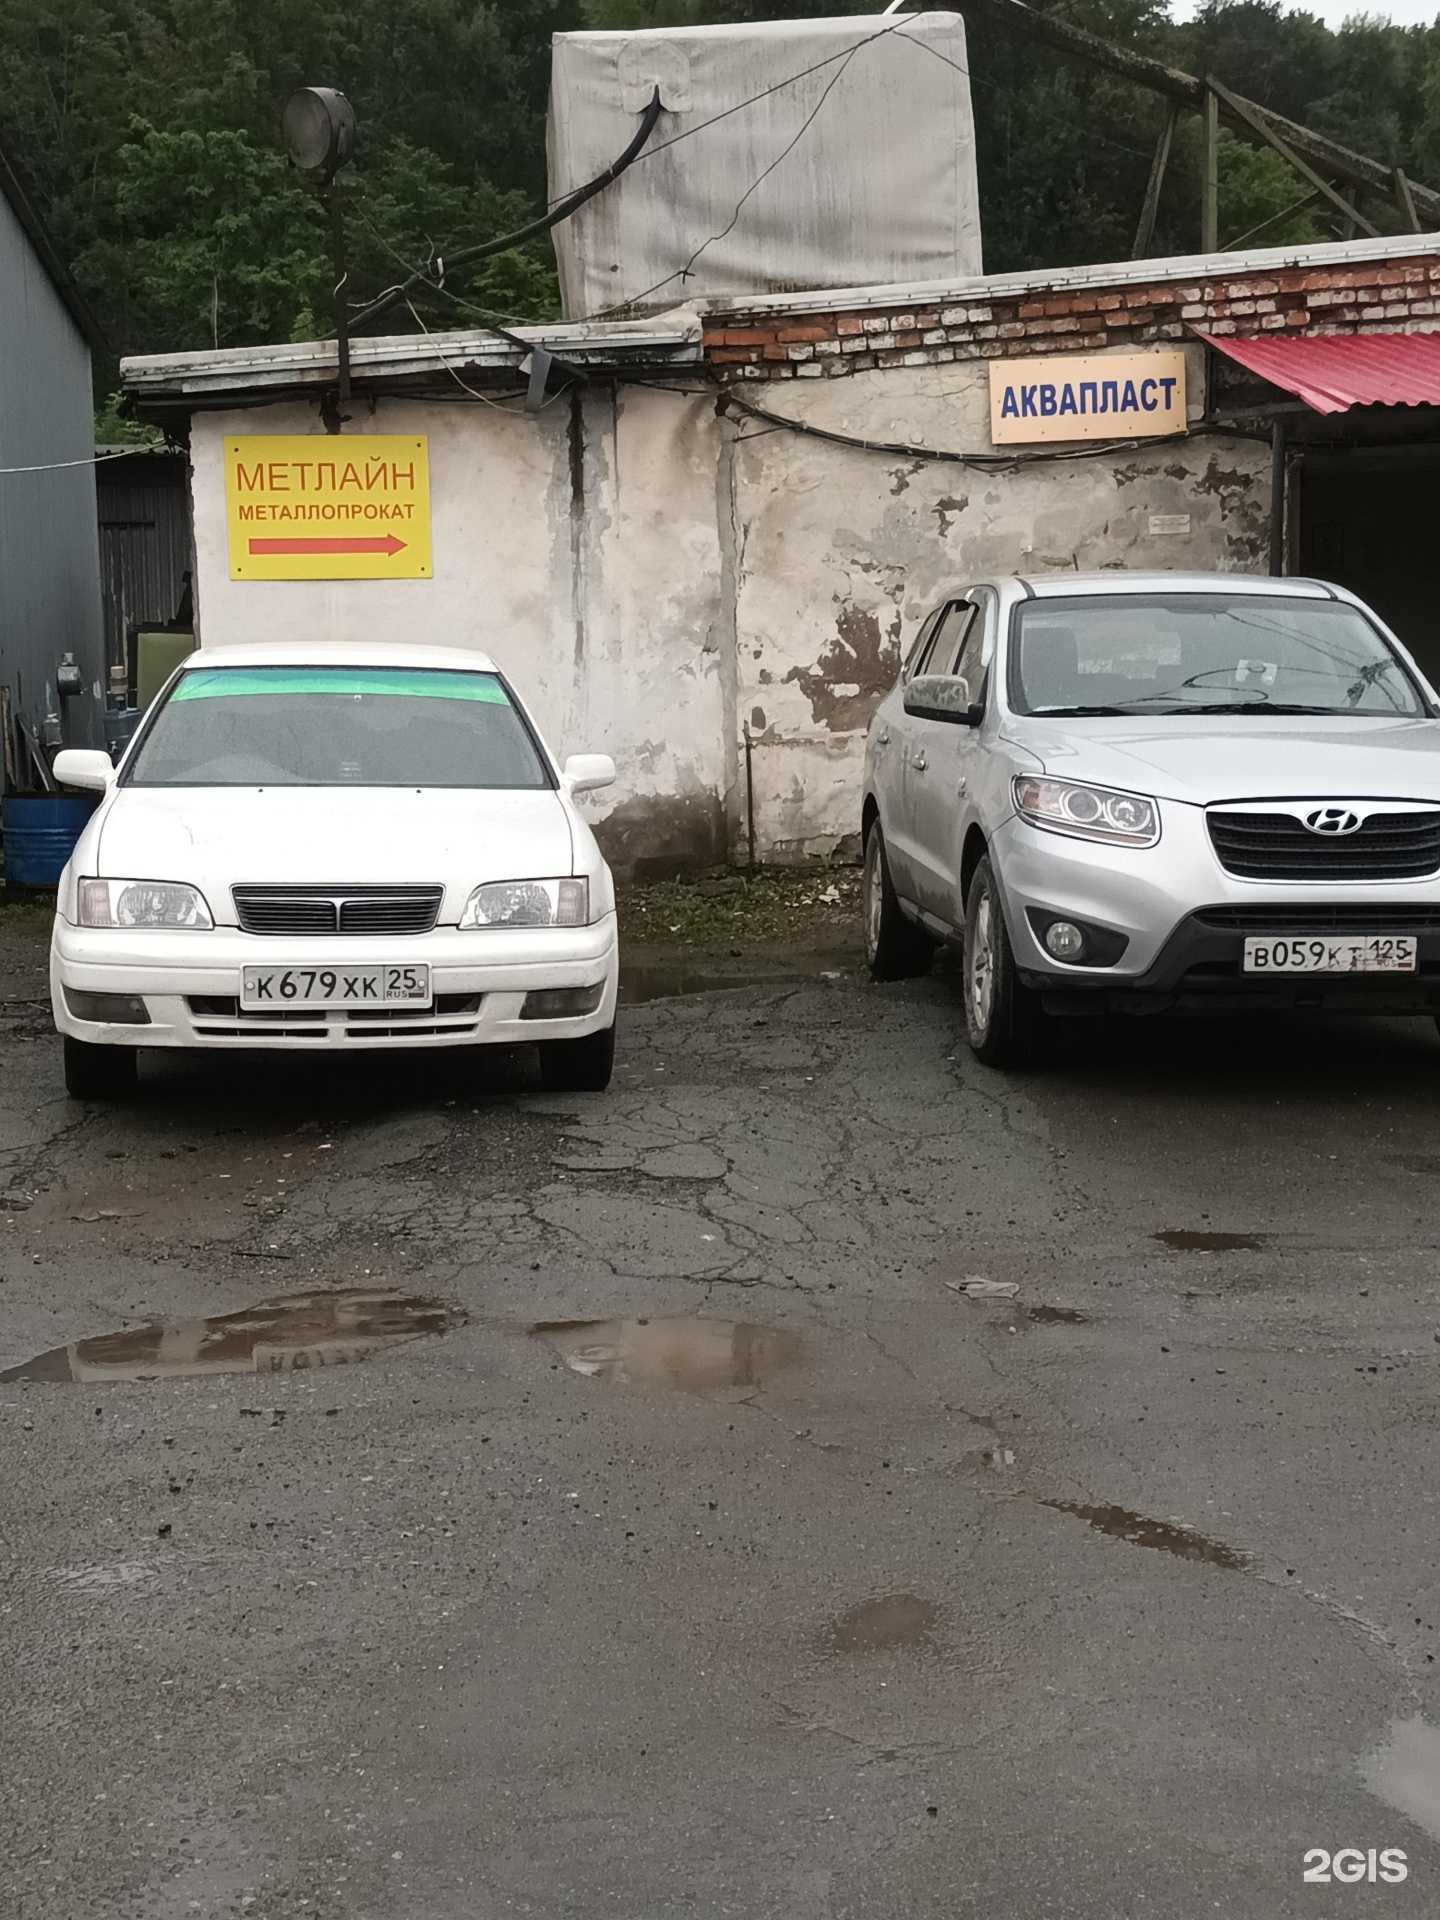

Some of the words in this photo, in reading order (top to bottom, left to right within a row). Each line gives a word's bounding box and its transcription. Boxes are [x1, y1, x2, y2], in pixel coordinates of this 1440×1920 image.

[1001, 378, 1177, 418] АКВАПЛАСТ
[236, 456, 415, 491] МЕТЛАЙН
[239, 504, 415, 520] МЕТАЛЛОПРОКАТ
[388, 969, 416, 990] 25
